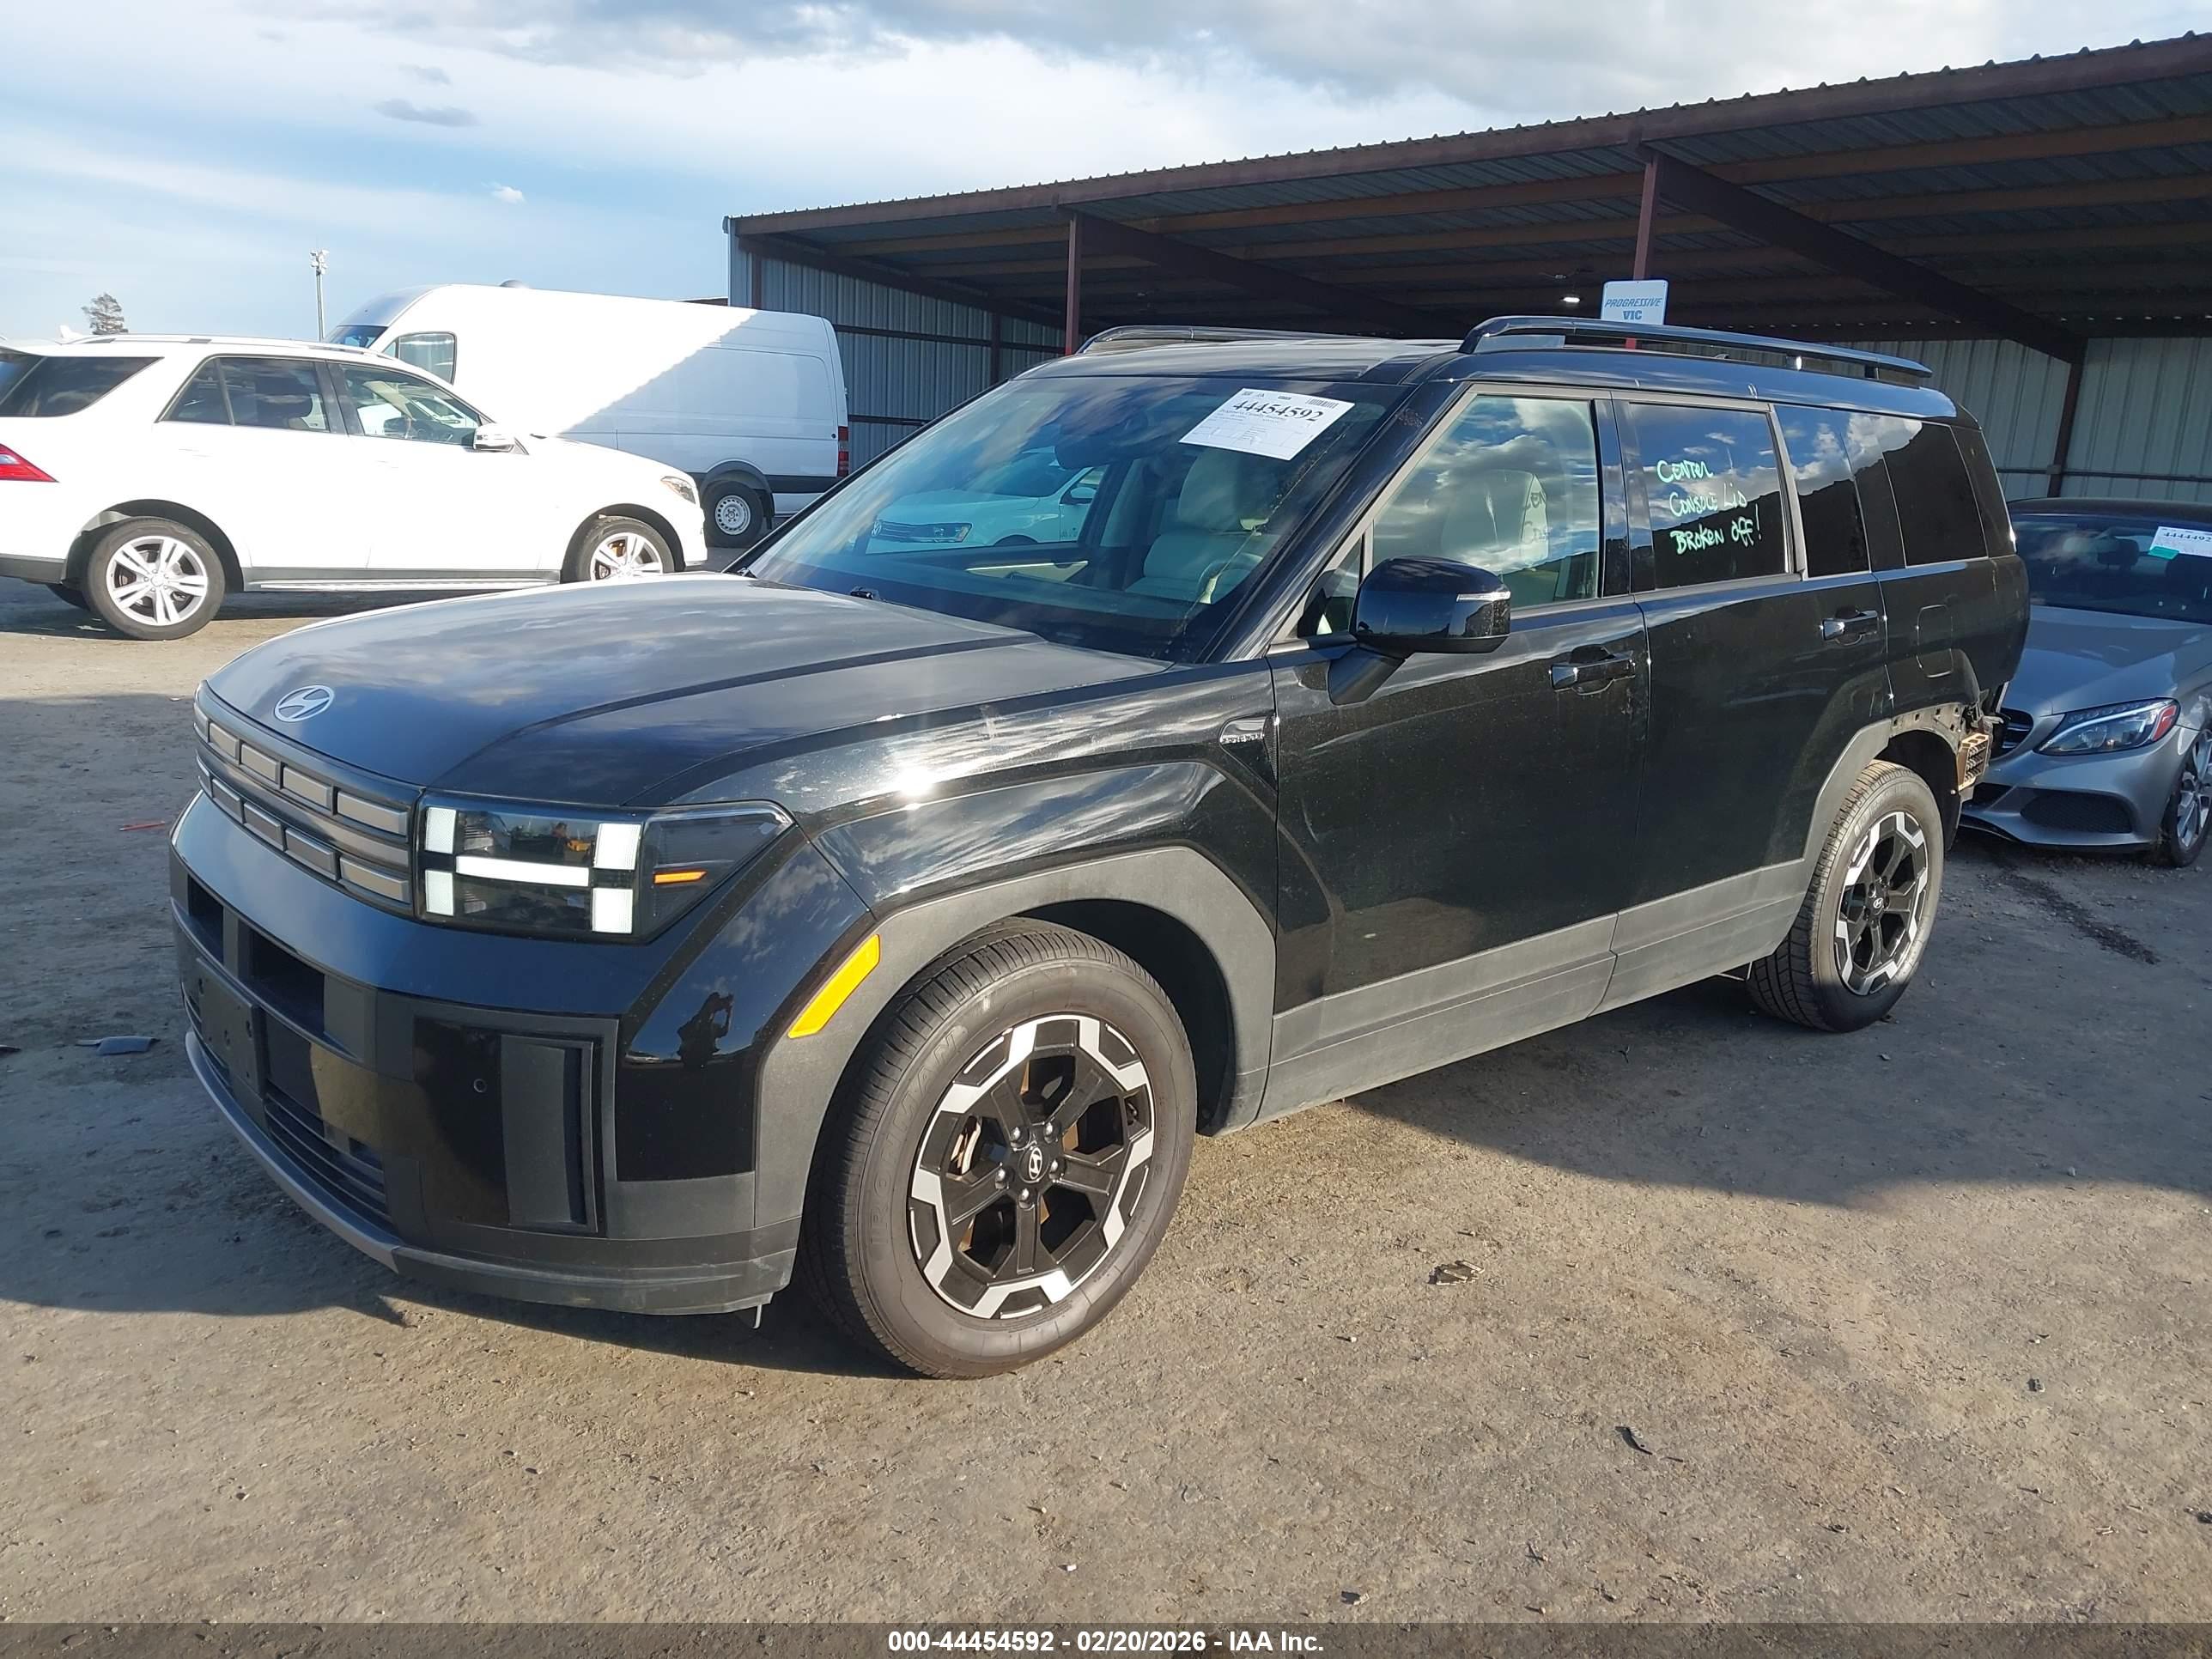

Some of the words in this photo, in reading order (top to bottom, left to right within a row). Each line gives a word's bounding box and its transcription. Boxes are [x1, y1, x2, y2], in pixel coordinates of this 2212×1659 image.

[1605, 297, 1662, 307] PROGRESSIVE
[1623, 310, 1643, 320] VIC
[1233, 400, 1324, 422] 44454592
